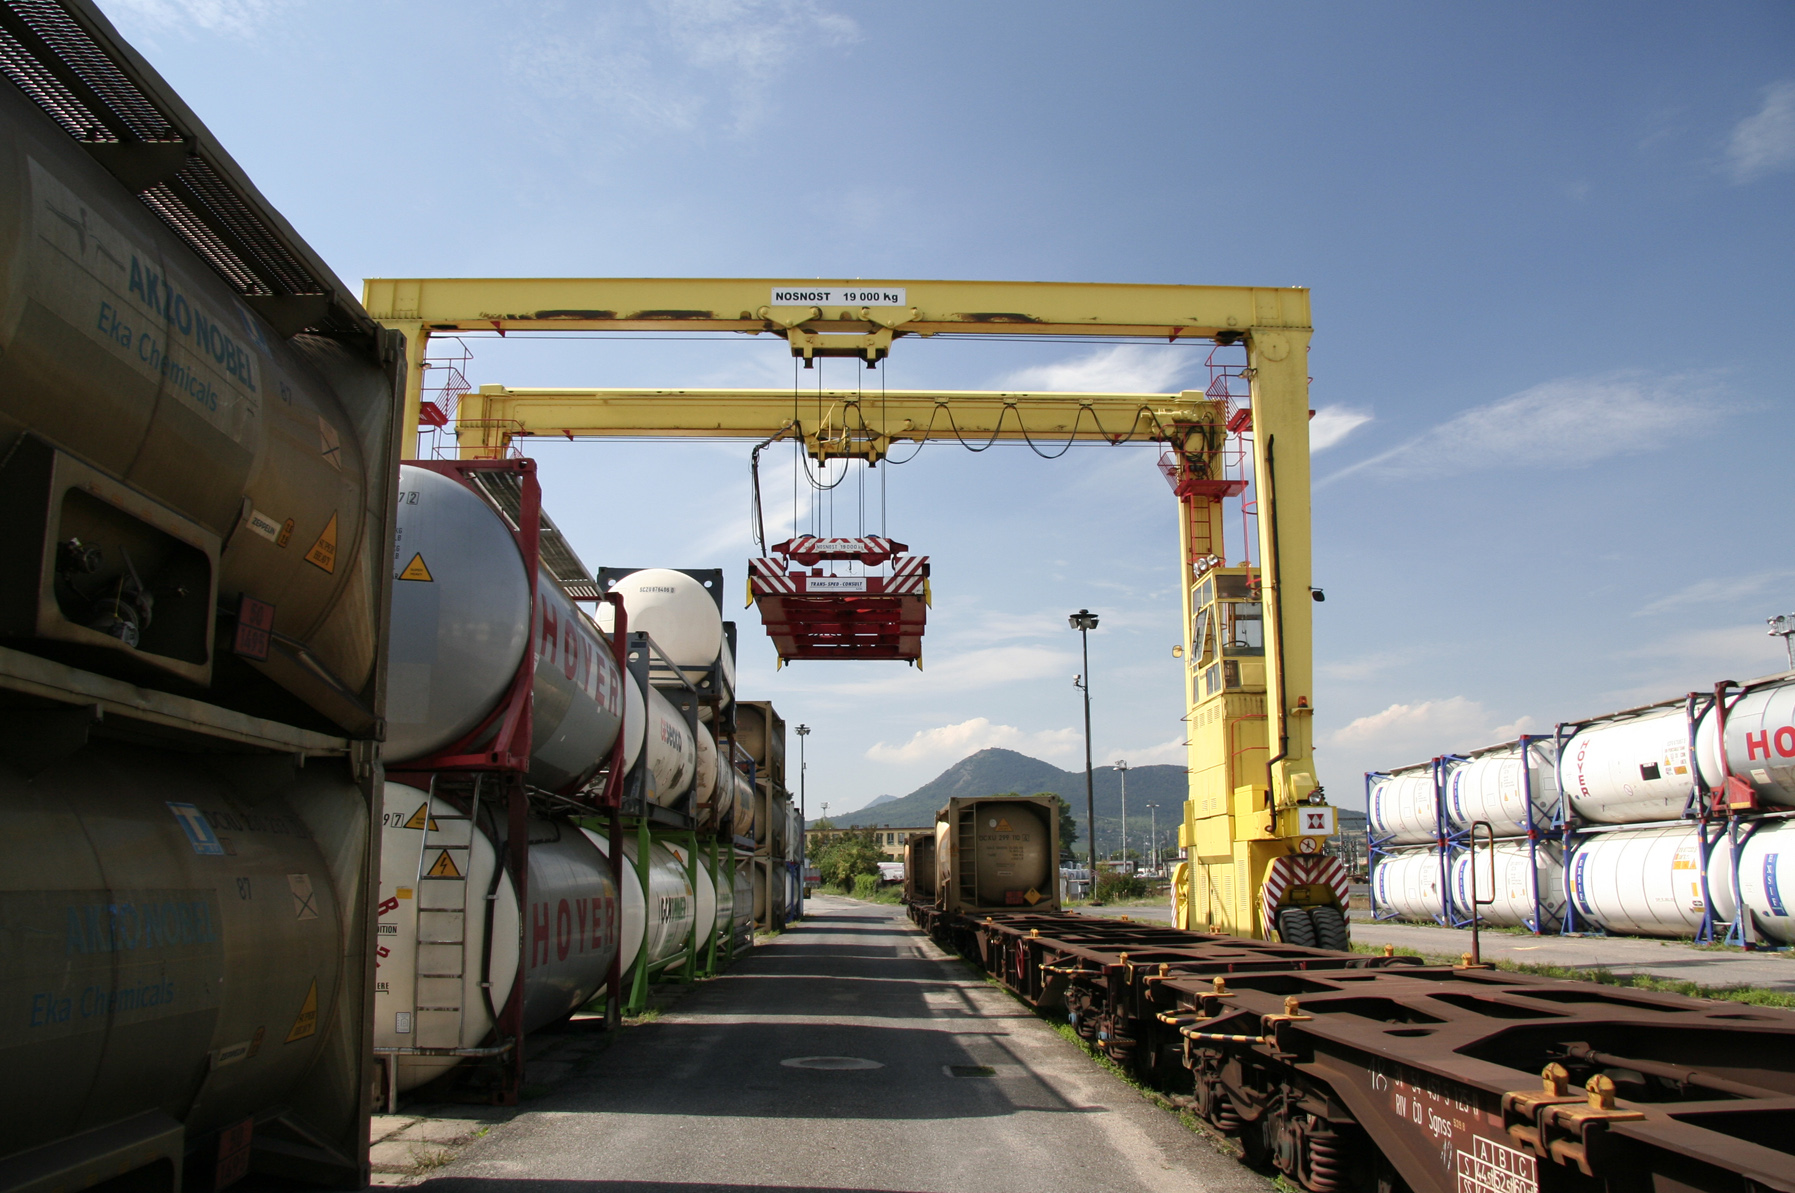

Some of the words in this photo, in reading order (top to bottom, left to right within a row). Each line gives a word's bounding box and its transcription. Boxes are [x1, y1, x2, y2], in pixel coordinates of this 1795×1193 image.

[129, 254, 192, 336] AKZO
[193, 307, 256, 393] NOBEL
[775, 292, 831, 302] NOSNOST
[843, 292, 857, 302] 19
[859, 292, 882, 302] 000
[97, 301, 133, 350] Eka
[138, 332, 218, 412] Chemicals
[540, 594, 619, 717] HOYER
[1577, 739, 1592, 798] HOYER
[64, 902, 142, 956] AKZO
[142, 901, 217, 949] NOBEL
[531, 896, 615, 969] HOYER
[29, 991, 73, 1028] Eka
[80, 976, 176, 1019] Chemicals
[1395, 1093, 1408, 1118] RIV
[1427, 1107, 1453, 1139] Sgnss
[1464, 1157, 1471, 1176] S
[1480, 1141, 1489, 1161] A
[1498, 1148, 1507, 1169] B
[1518, 1156, 1527, 1178] C
